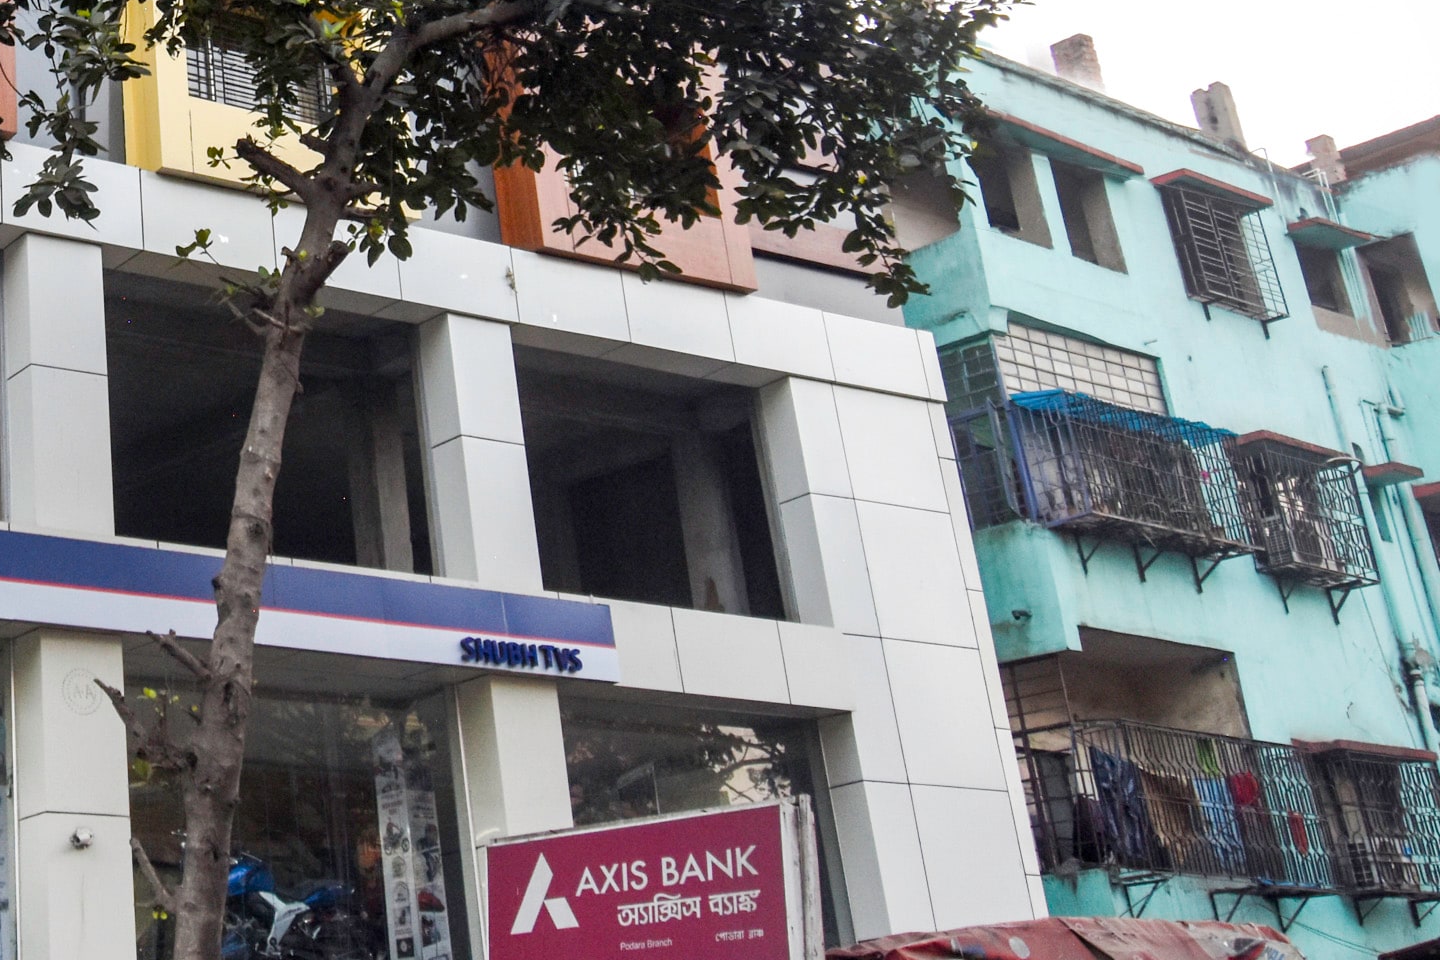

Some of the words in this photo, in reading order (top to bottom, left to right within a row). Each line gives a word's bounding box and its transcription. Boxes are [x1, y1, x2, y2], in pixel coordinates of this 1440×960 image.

[460, 636, 539, 670] SHUBH
[538, 644, 583, 674] TVS
[575, 860, 649, 898] AXIS
[661, 844, 759, 886] BANK
[620, 941, 646, 951] Podara
[647, 938, 673, 948] Branch
